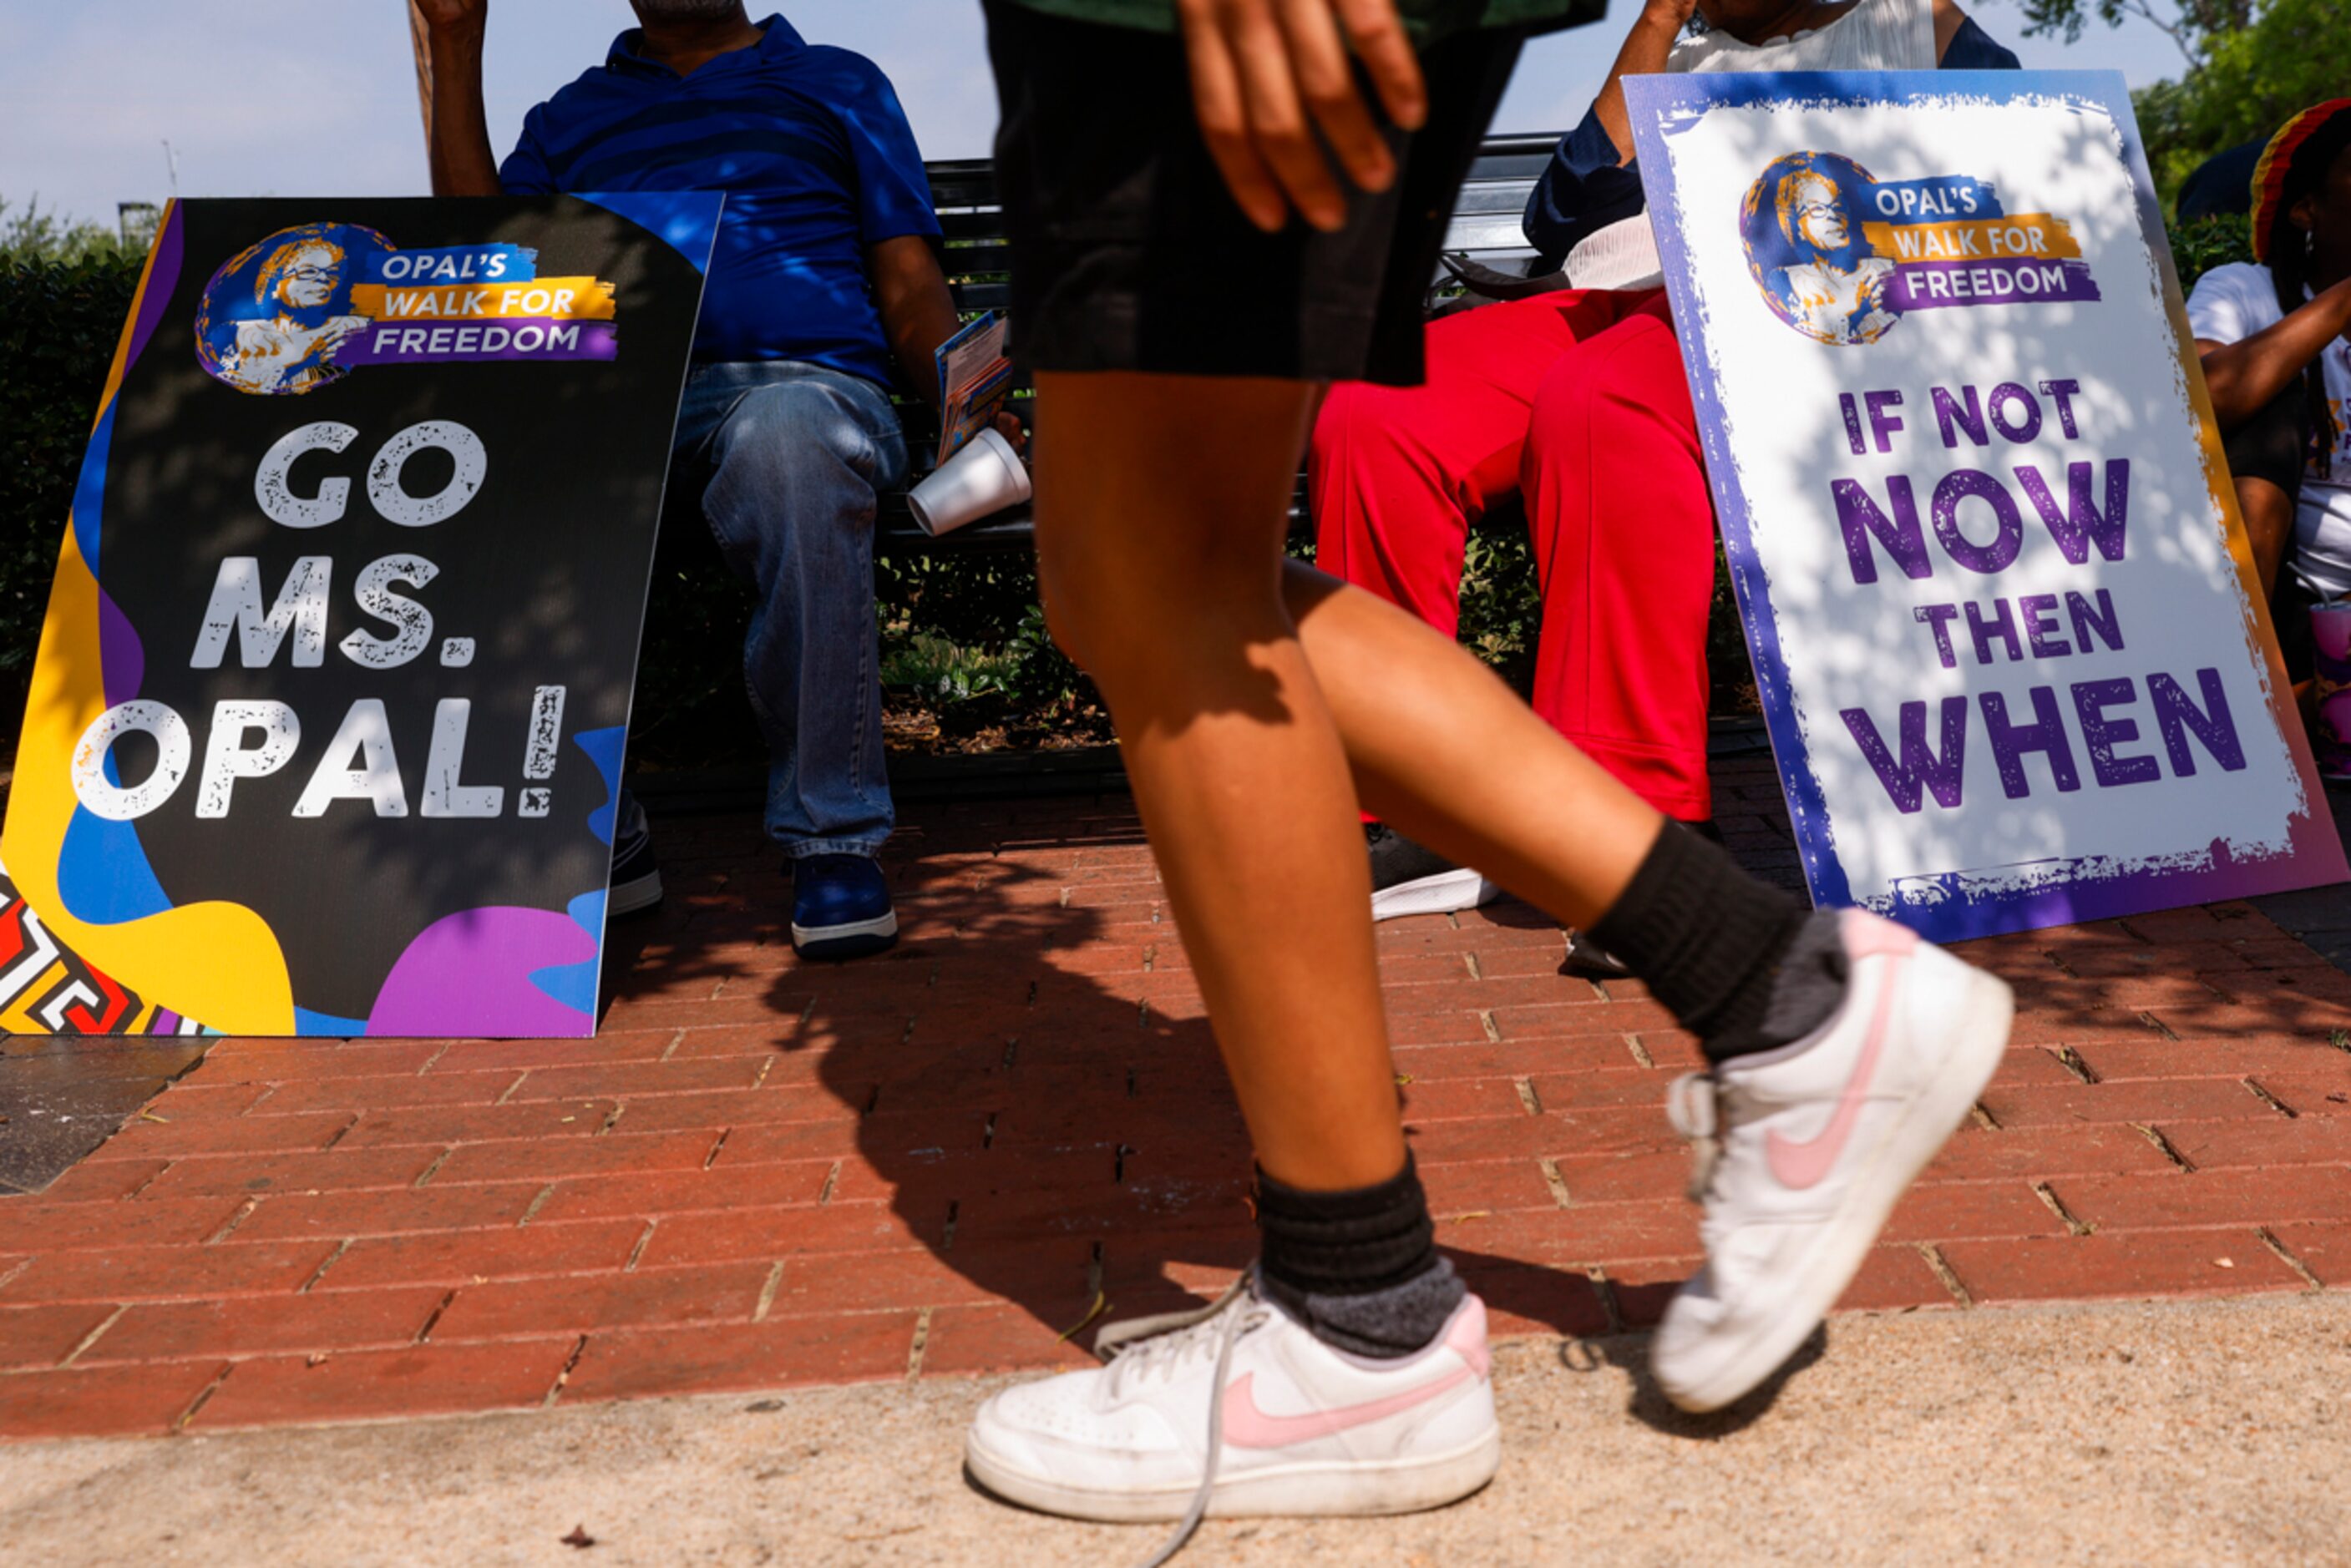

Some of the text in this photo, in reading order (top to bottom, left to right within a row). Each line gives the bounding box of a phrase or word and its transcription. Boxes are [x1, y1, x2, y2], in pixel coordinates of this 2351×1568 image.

[1876, 186, 1978, 216] OPAL'S
[382, 253, 508, 279] OPAL'S
[1893, 226, 2049, 258] WALK FOR
[385, 288, 575, 316] WALK FOR
[1905, 266, 2068, 300] FREEDOM
[372, 326, 580, 354] FREEDOM
[1838, 379, 2081, 455] IF NOT
[254, 419, 488, 529] GO
[1831, 458, 2130, 584] NOW
[189, 553, 476, 669] MS.
[1913, 588, 2125, 668] THEN
[70, 685, 567, 821] OPAL!
[1839, 667, 2247, 814] WHEN
